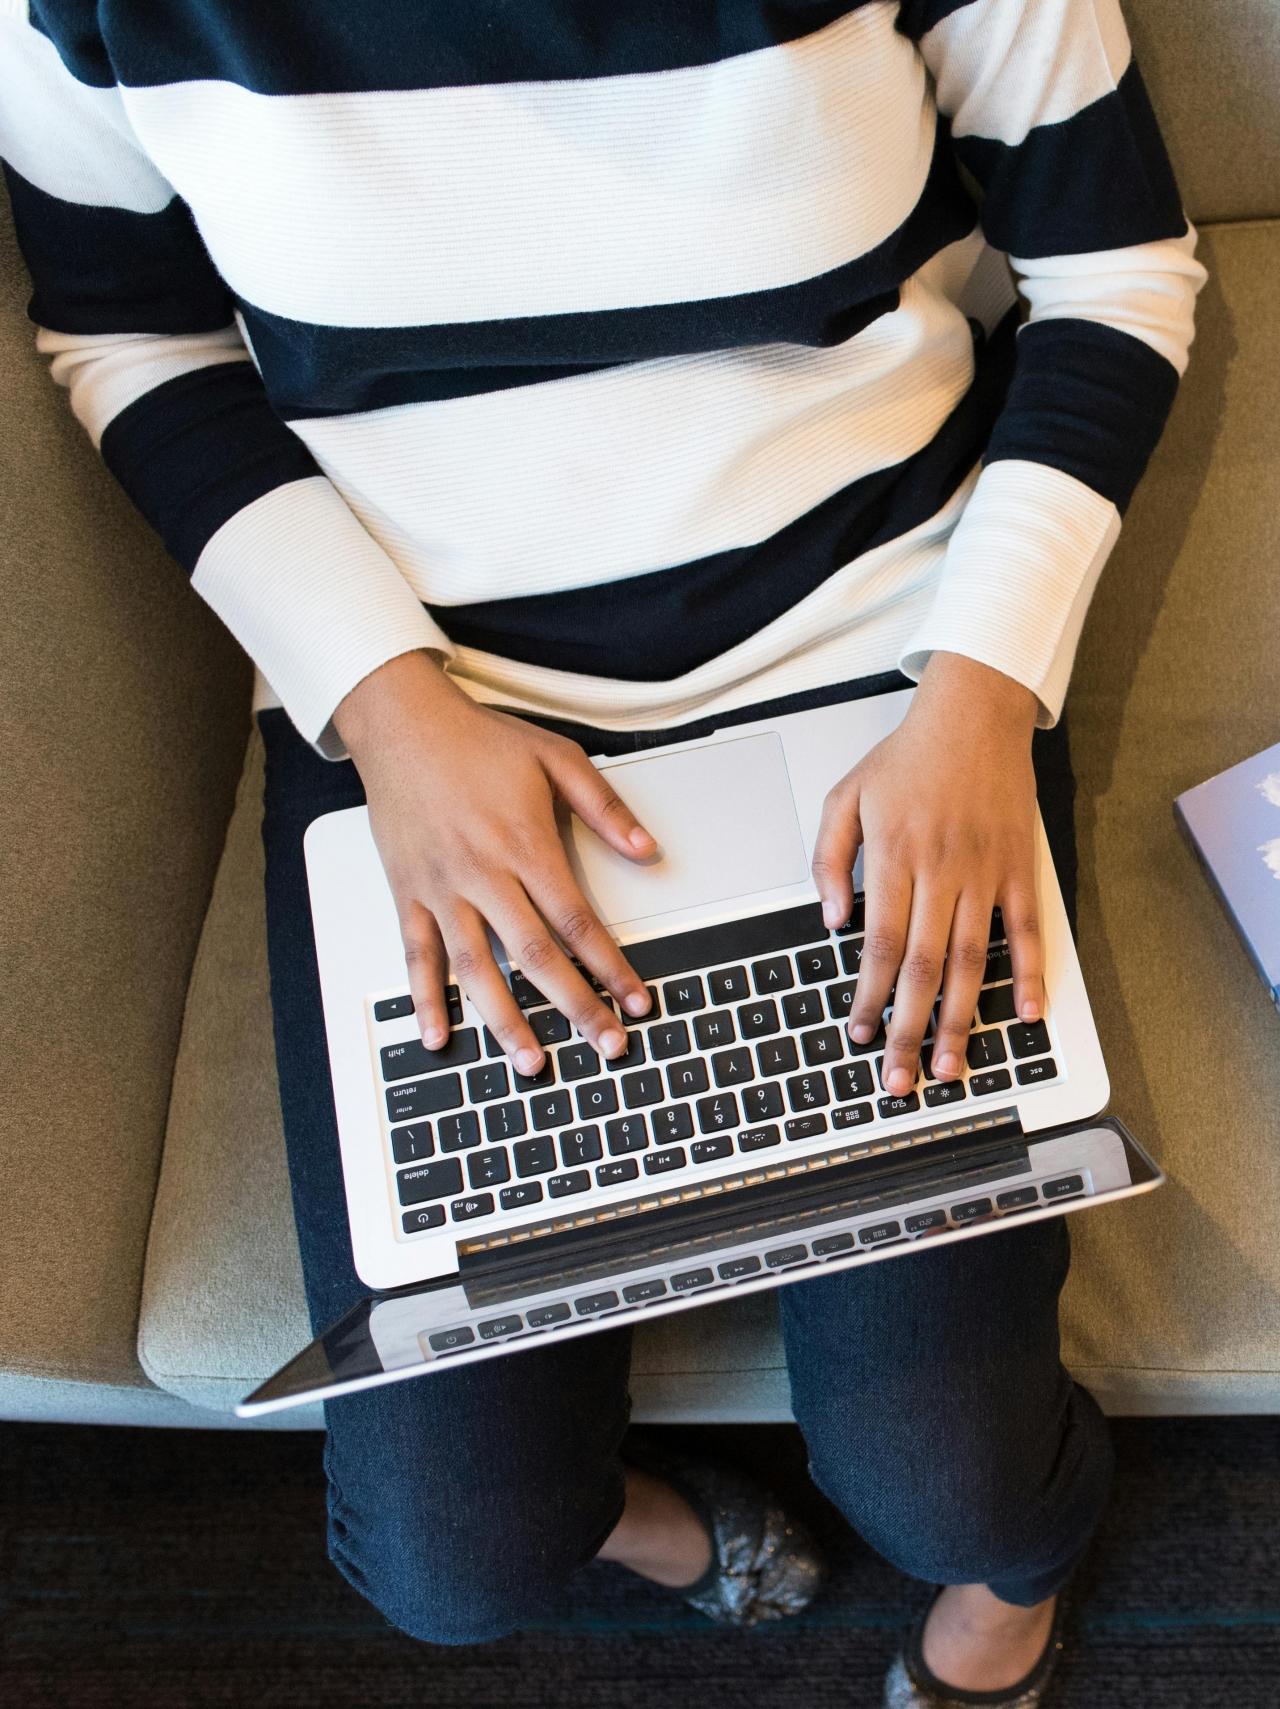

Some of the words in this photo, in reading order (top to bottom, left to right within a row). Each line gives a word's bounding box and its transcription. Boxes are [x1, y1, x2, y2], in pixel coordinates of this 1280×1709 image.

[811, 959, 822, 970] C
[768, 969, 778, 981] V
[724, 979, 733, 990] B
[679, 989, 689, 1000] N
[842, 992, 852, 1003] D
[800, 1003, 807, 1014] F
[753, 1013, 763, 1024] G
[708, 1023, 719, 1035] H
[666, 1033, 672, 1045] J
[818, 1040, 826, 1051] R
[387, 1047, 405, 1058] shift
[774, 1051, 782, 1062] T
[574, 1054, 582, 1065] L
[729, 1061, 737, 1073] Y
[682, 1071, 693, 1083] U
[848, 1069, 855, 1079] 4
[802, 1079, 810, 1090] 5
[851, 1082, 858, 1092] $
[393, 1086, 417, 1097] return
[757, 1090, 765, 1100] 6
[592, 1093, 602, 1104] O
[804, 1094, 815, 1102] %
[395, 1105, 413, 1114] enter
[547, 1103, 556, 1115] P
[714, 1100, 720, 1111] 7
[667, 1112, 675, 1122] 8
[715, 1114, 723, 1124] &
[622, 1122, 629, 1132] 9
[576, 1133, 583, 1144] 0
[404, 1169, 429, 1180] delete
